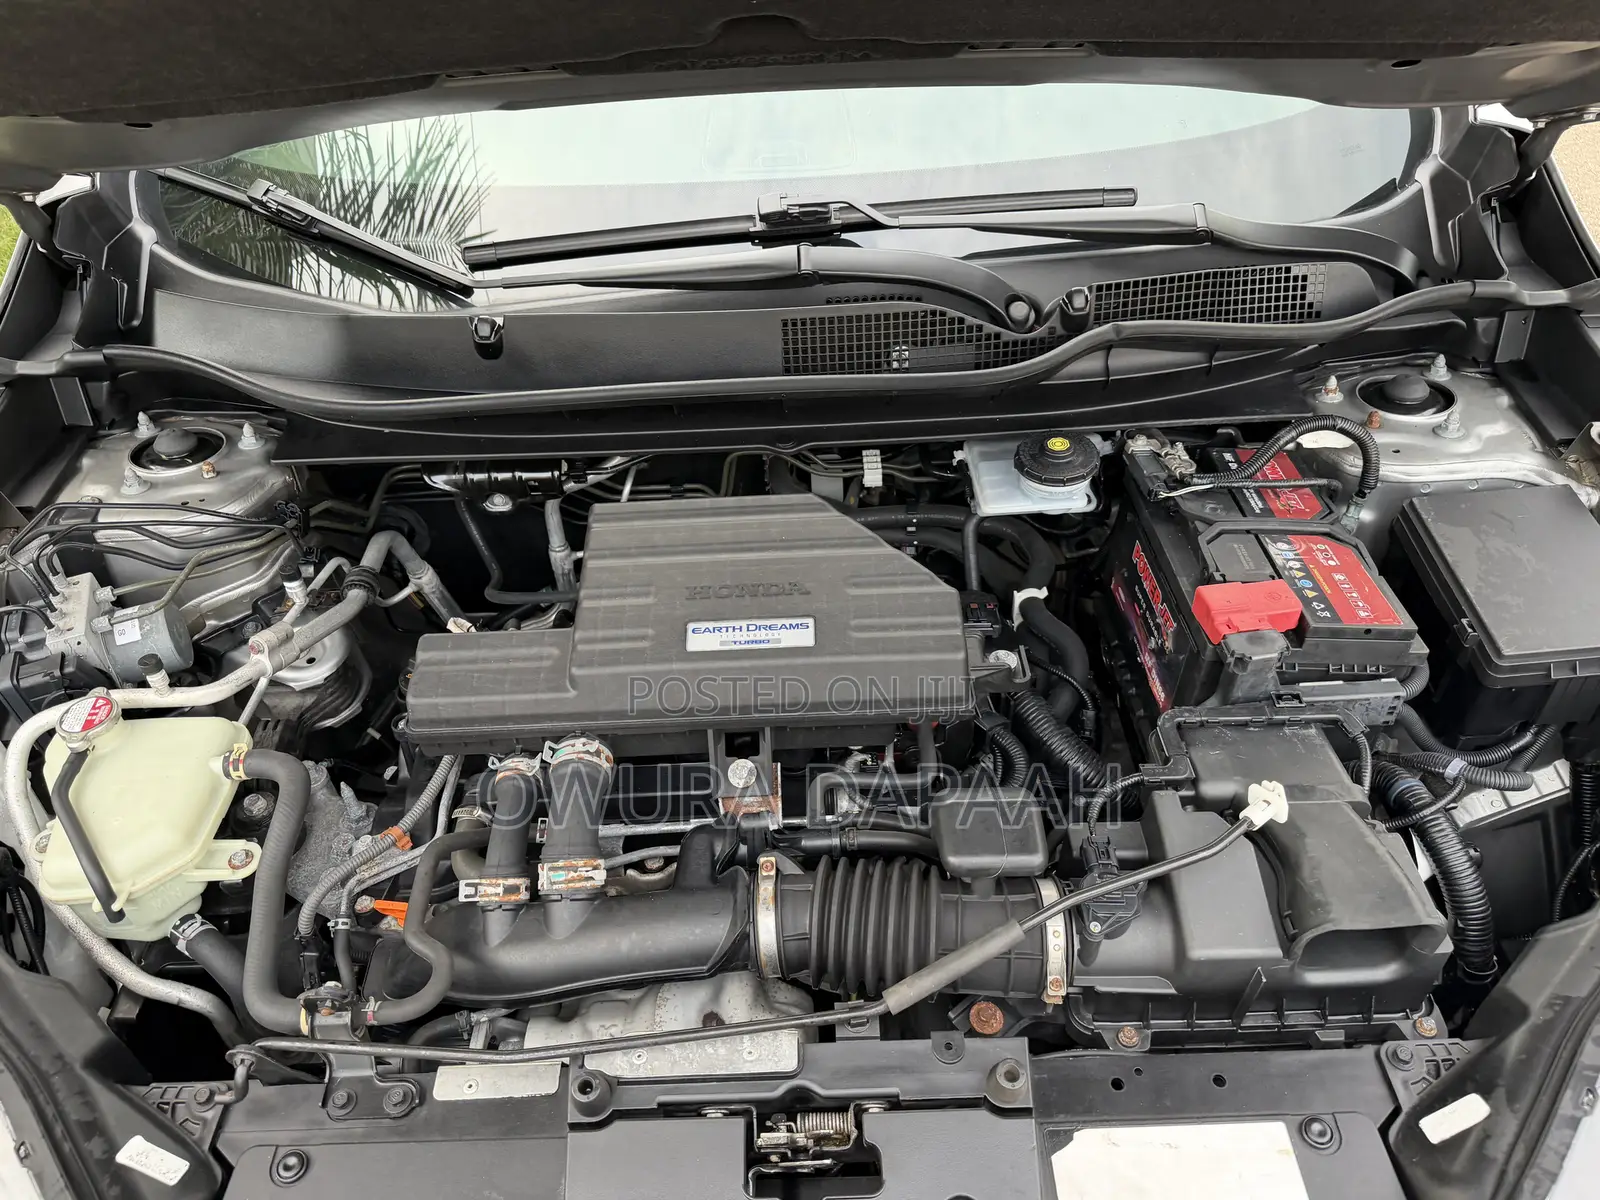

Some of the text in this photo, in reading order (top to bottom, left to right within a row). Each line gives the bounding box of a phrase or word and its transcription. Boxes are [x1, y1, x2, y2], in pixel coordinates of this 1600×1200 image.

[685, 581, 811, 600] HONDA
[691, 622, 810, 635] EARTH DREAMS
